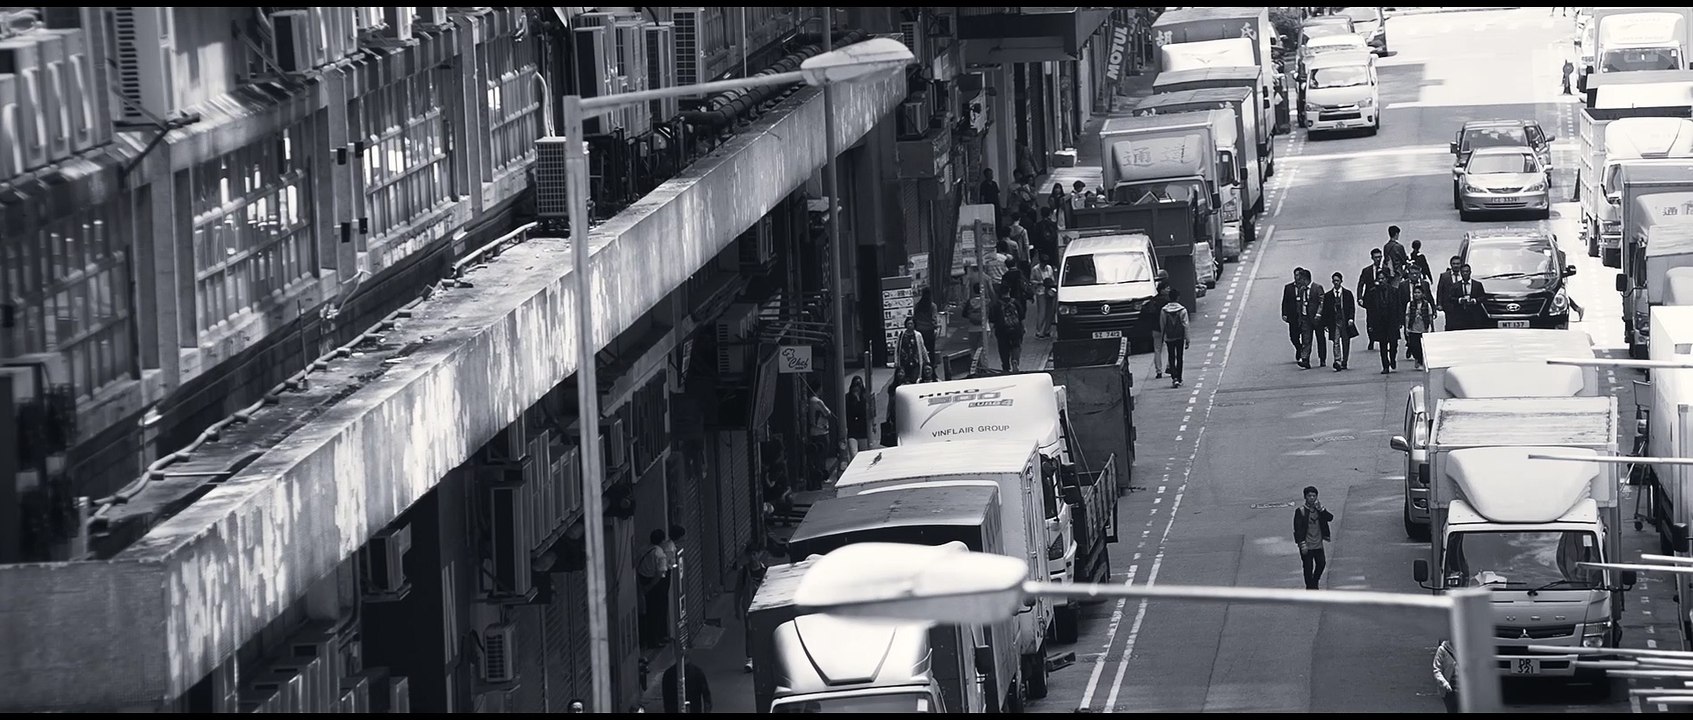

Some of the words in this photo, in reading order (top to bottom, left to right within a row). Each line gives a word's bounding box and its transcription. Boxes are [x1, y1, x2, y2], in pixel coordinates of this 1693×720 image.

[1106, 26, 1128, 80] MOTUL
[931, 426, 974, 438] VINFLAIR
[977, 425, 1010, 433] GROUP
